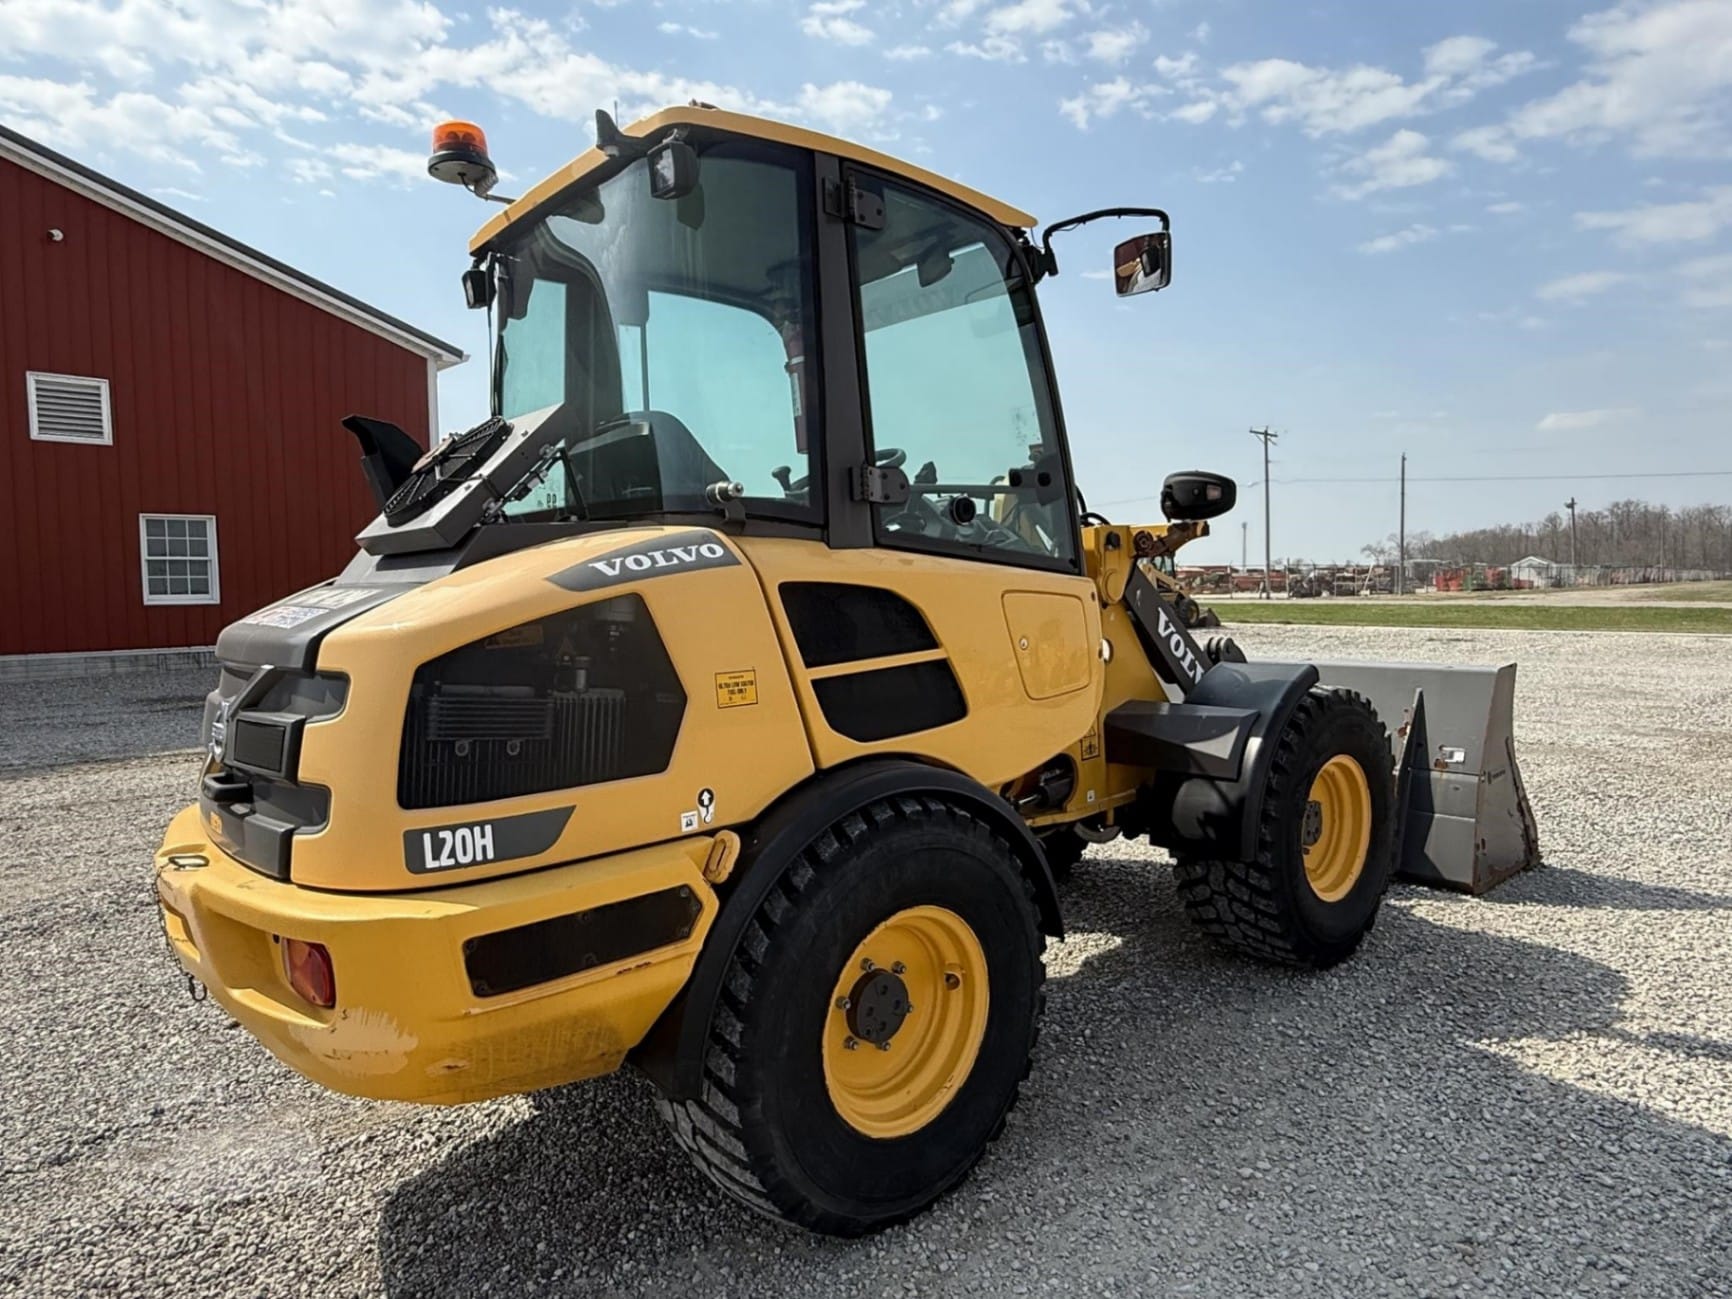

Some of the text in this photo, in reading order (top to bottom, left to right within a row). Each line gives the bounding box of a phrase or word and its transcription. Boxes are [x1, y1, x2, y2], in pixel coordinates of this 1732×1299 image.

[588, 542, 724, 577] VOLVO
[1157, 606, 1205, 685] VOLV
[422, 823, 496, 869] L20H
